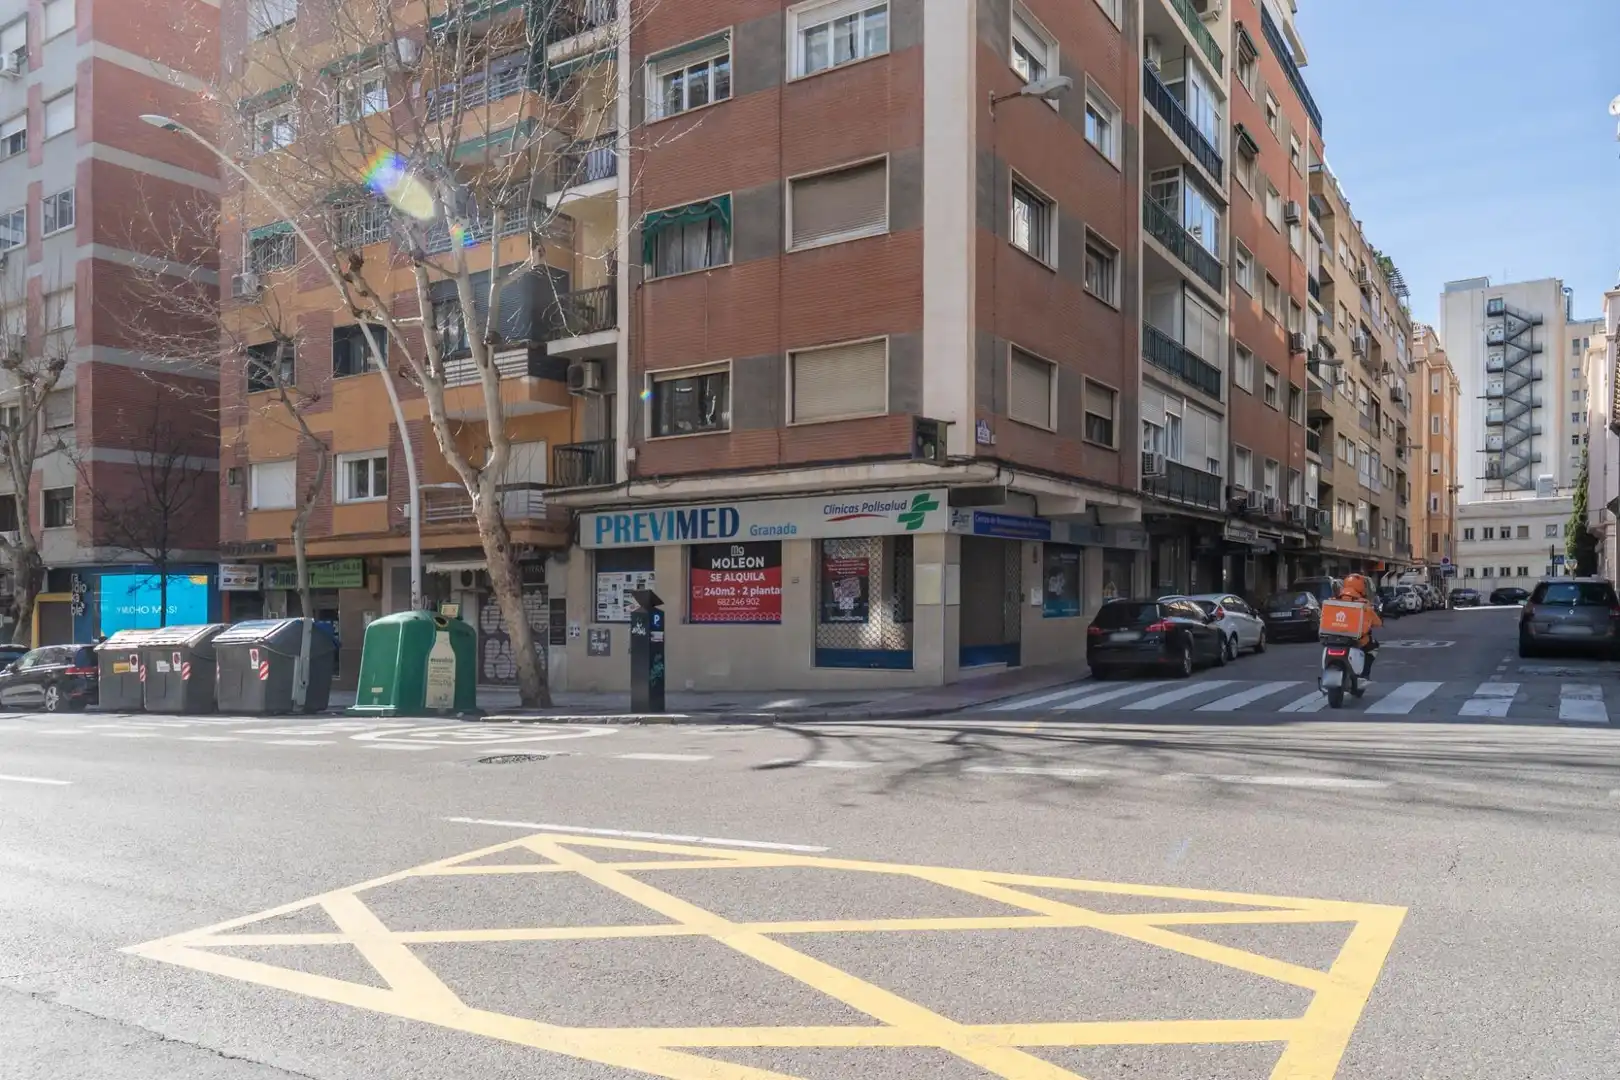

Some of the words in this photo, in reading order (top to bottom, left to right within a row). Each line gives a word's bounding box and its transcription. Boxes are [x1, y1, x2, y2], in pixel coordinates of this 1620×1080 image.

[862, 499, 908, 513] Polisalud
[595, 507, 740, 544] PREVIMED
[750, 522, 797, 537] Granada
[711, 556, 765, 569] MOLEON
[710, 573, 722, 582] SE
[723, 572, 766, 583] ALQUILA
[704, 586, 735, 596] 240m2
[742, 586, 749, 596] 2
[750, 585, 782, 597] planta
[653, 614, 661, 625] P
